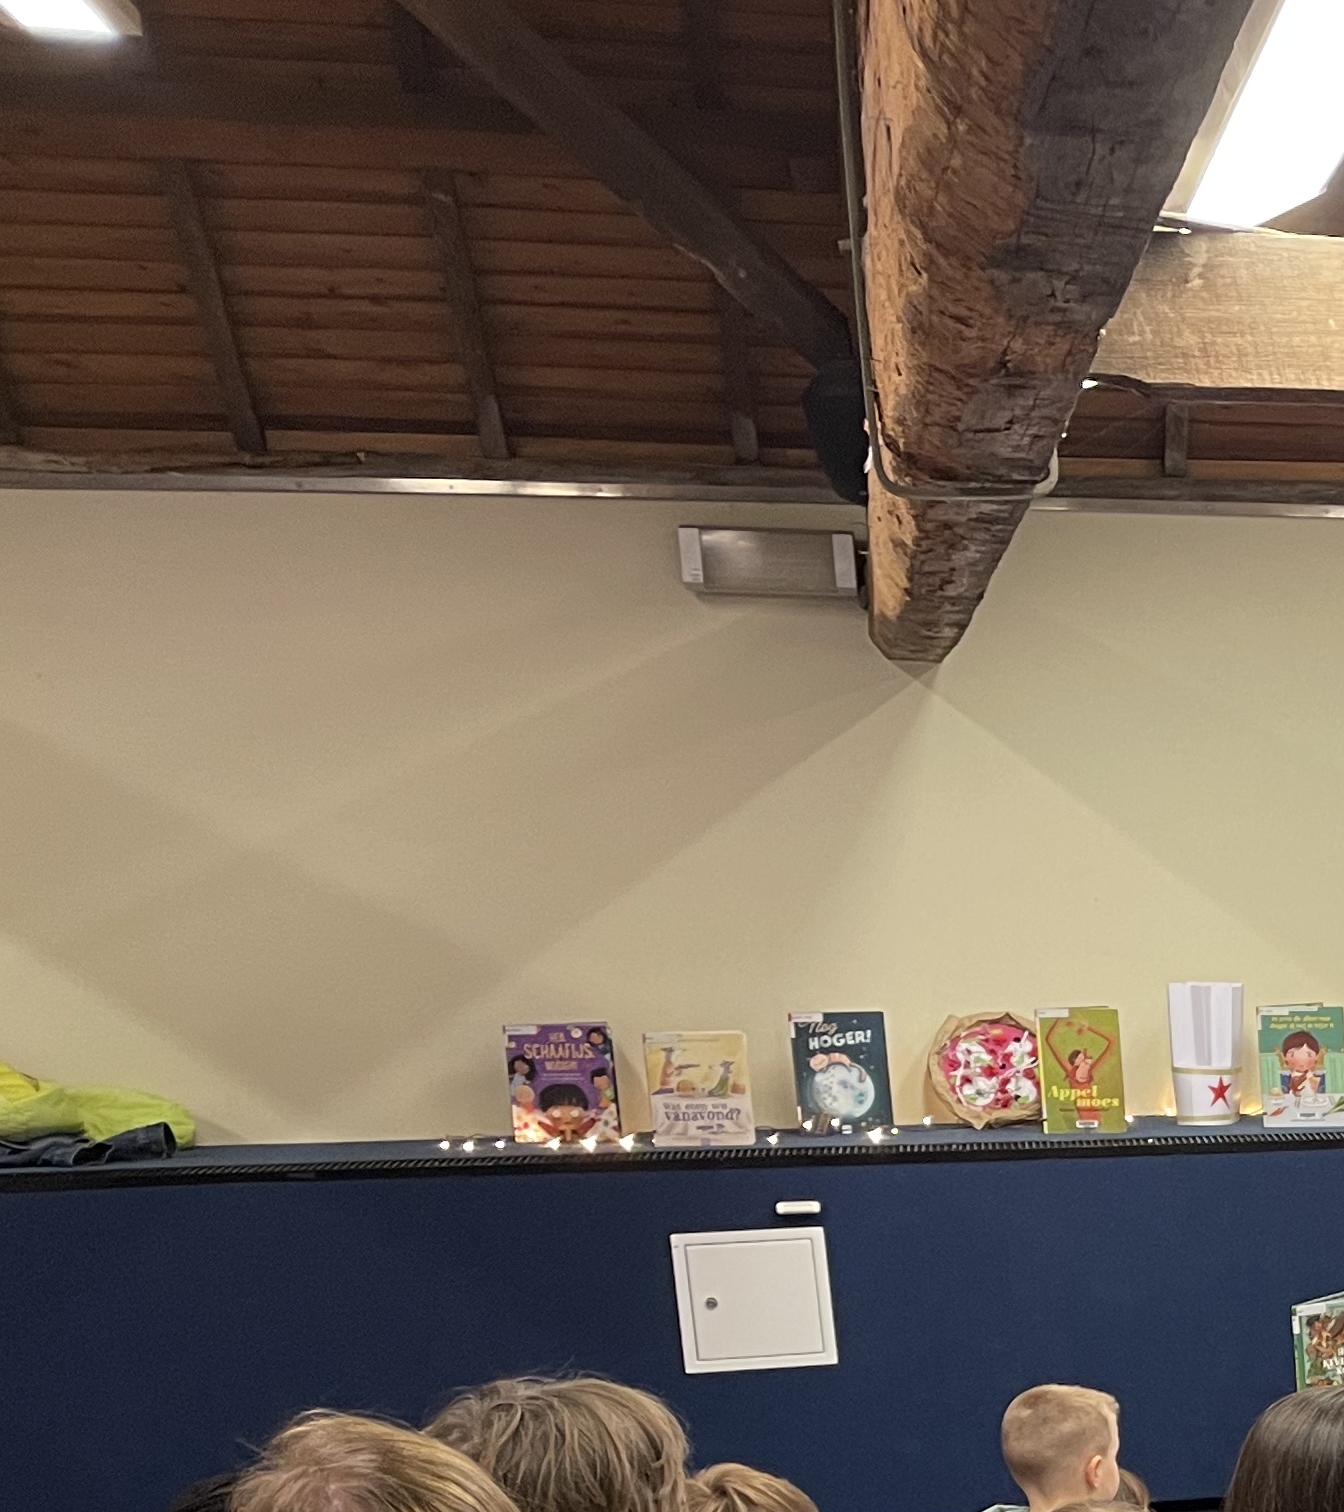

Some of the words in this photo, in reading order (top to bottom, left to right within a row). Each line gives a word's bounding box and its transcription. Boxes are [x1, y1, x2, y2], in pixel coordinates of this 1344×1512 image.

[807, 1028, 873, 1051] HOGER!
[1047, 1085, 1098, 1101] Appel
[1076, 1097, 1120, 1108] moes
[664, 1107, 742, 1122] vanavond?
